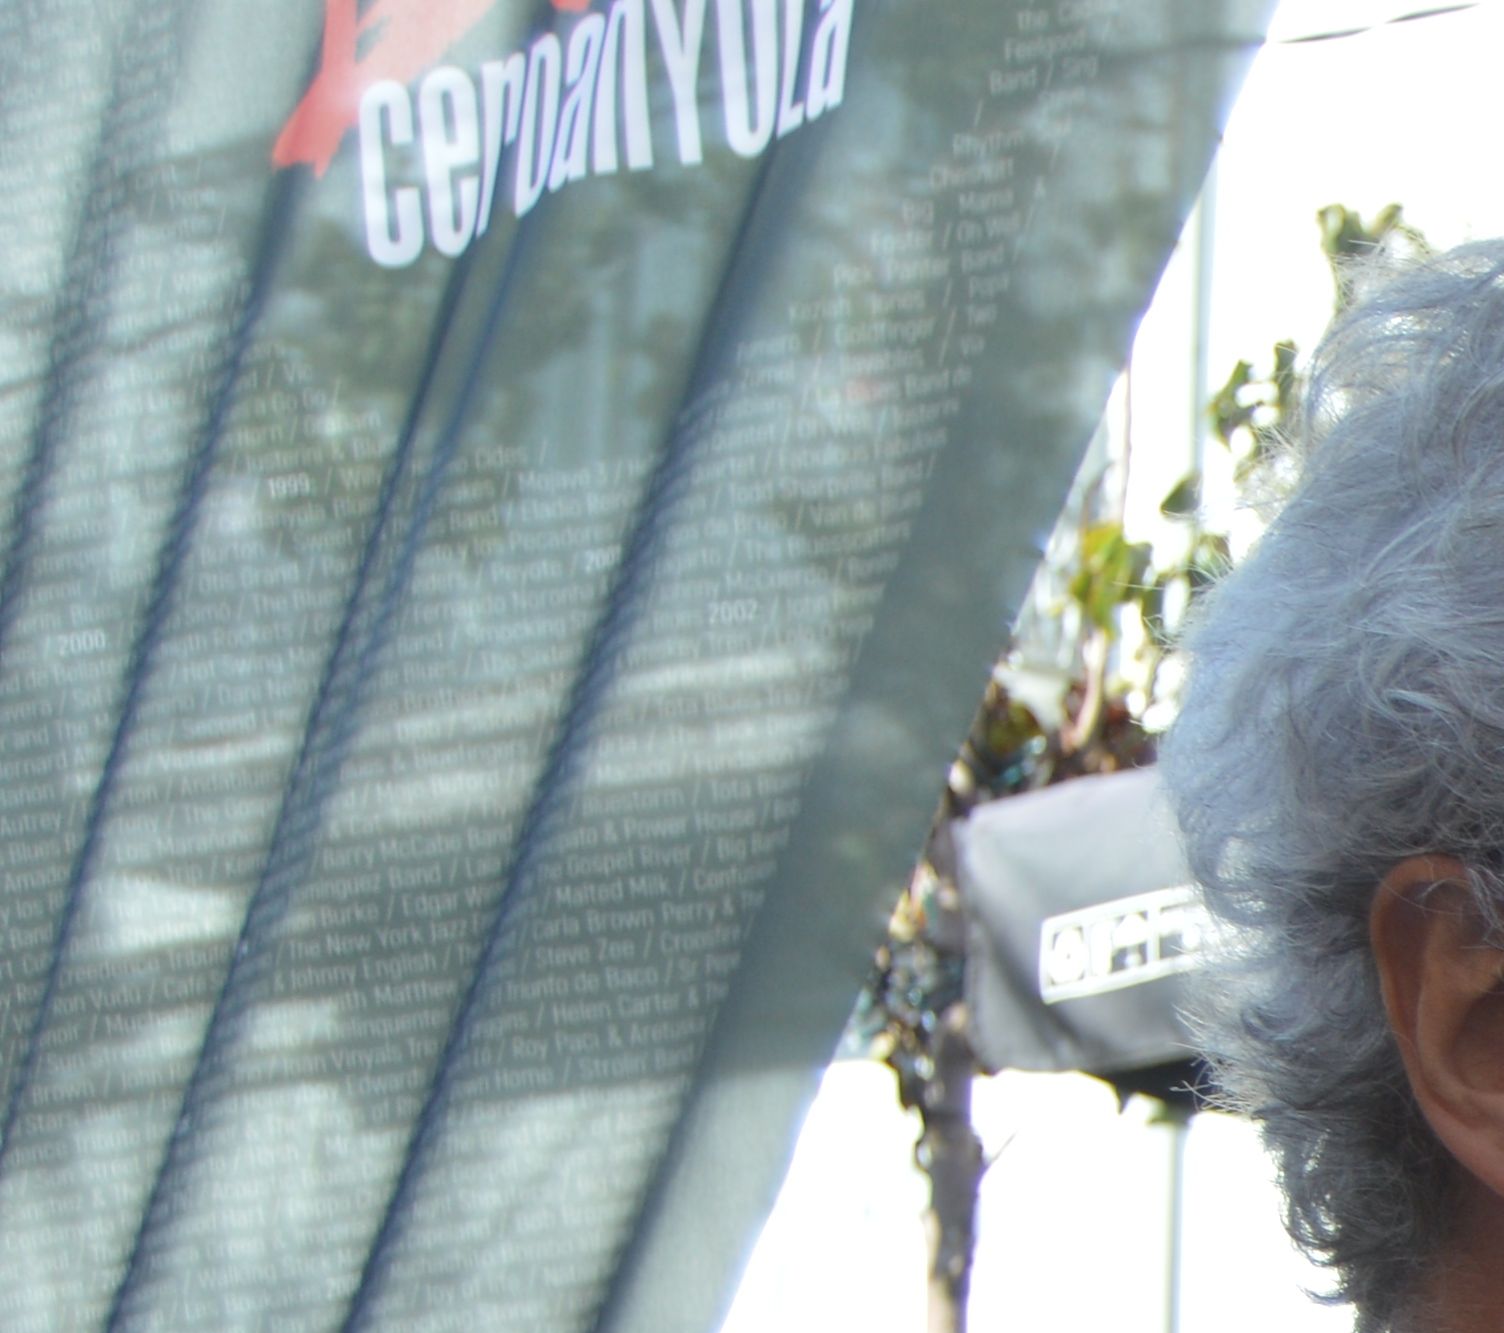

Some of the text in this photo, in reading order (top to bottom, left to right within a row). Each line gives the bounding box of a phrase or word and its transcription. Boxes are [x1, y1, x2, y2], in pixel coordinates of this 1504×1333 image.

[268, 472, 310, 498] 1999
[708, 599, 758, 624] 2002
[57, 628, 106, 656] 2000
[604, 809, 756, 844] & Power House
[322, 823, 513, 871] Barry McCabe Band
[567, 848, 634, 877] Gospel
[641, 844, 691, 867] River
[388, 863, 441, 889] Band
[555, 873, 670, 907] Malted Milk
[320, 892, 458, 928] Burke Edgar
[532, 915, 580, 942] Carla
[586, 908, 655, 933] Brown
[662, 901, 716, 924] Perry
[722, 894, 734, 917] &
[289, 919, 468, 960] The New York Jazz
[535, 937, 635, 969] Steve Zee
[291, 965, 356, 989] Johnny
[362, 951, 436, 980] English
[574, 970, 599, 992] de
[605, 966, 659, 989] Baco
[553, 1001, 612, 1024] Helen
[618, 991, 679, 1017] Carter
[688, 985, 698, 1008] &
[512, 1036, 548, 1060] Roy
[608, 1023, 623, 1047] &
[495, 1066, 553, 1088] Home
